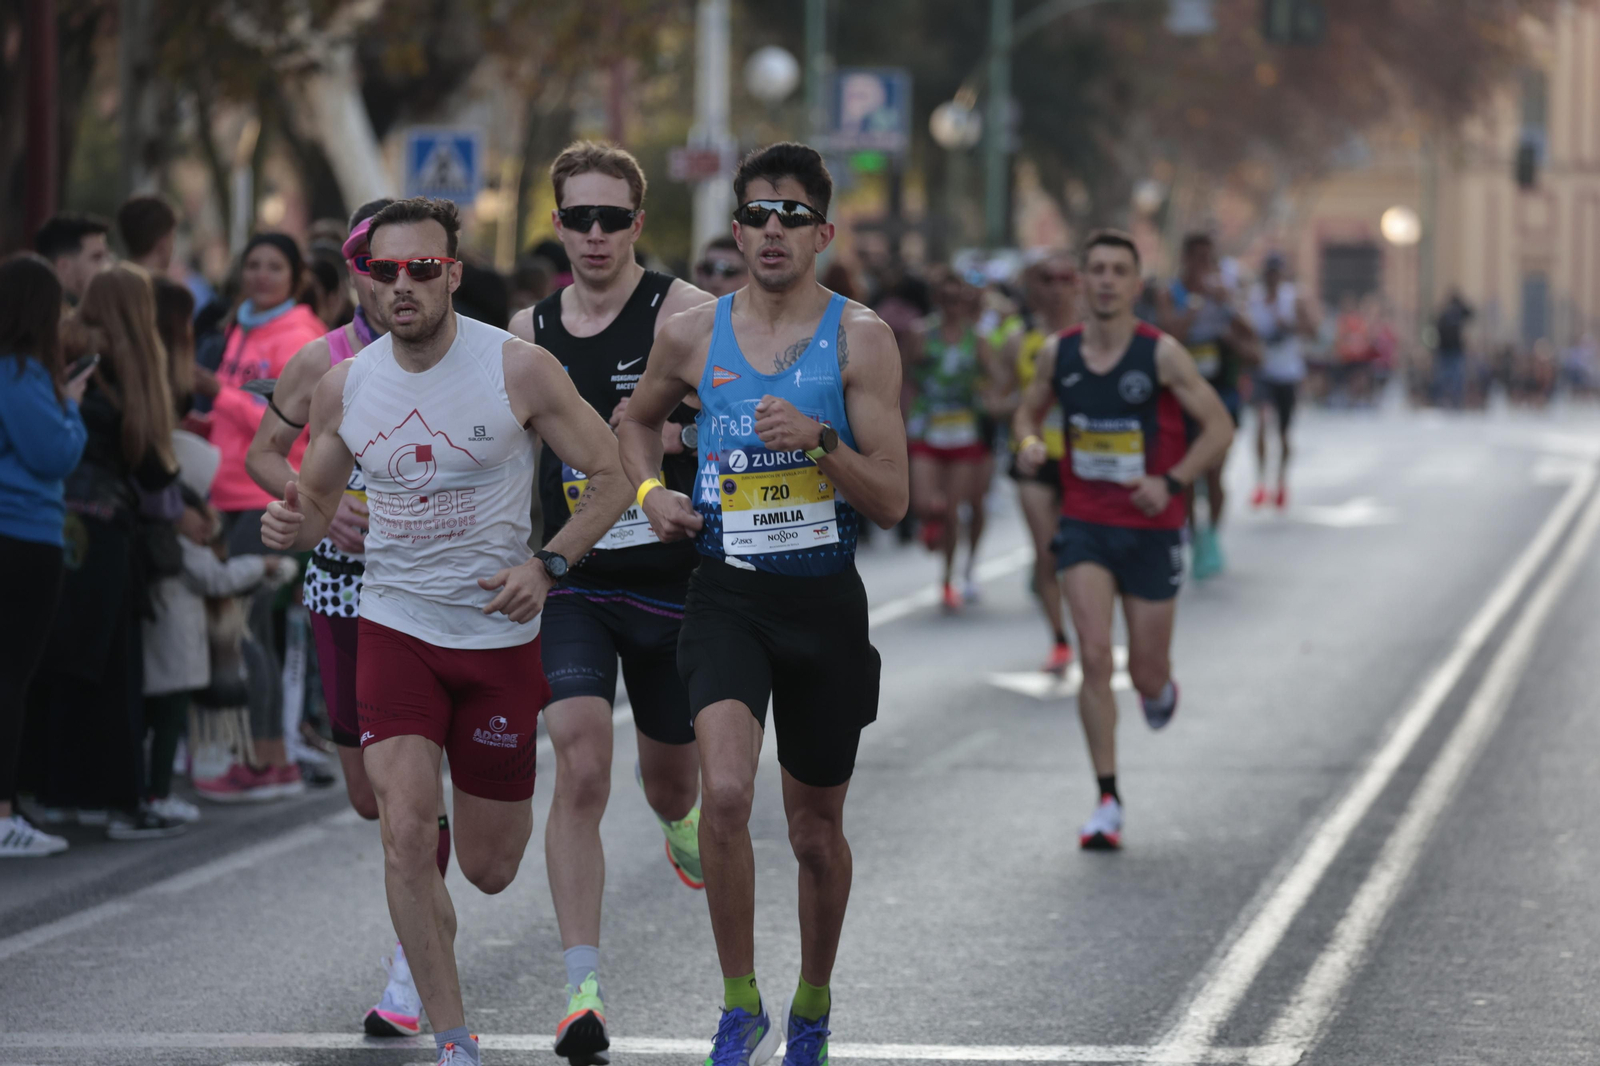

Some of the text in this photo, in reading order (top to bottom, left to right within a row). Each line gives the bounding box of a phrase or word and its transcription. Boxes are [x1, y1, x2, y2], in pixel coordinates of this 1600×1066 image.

[752, 449, 809, 468] ZURIC
[373, 487, 476, 517] ADOBE
[760, 484, 790, 502] 720
[753, 509, 805, 526] FAMILIA
[411, 534, 431, 544] your
[433, 528, 467, 541] comfort
